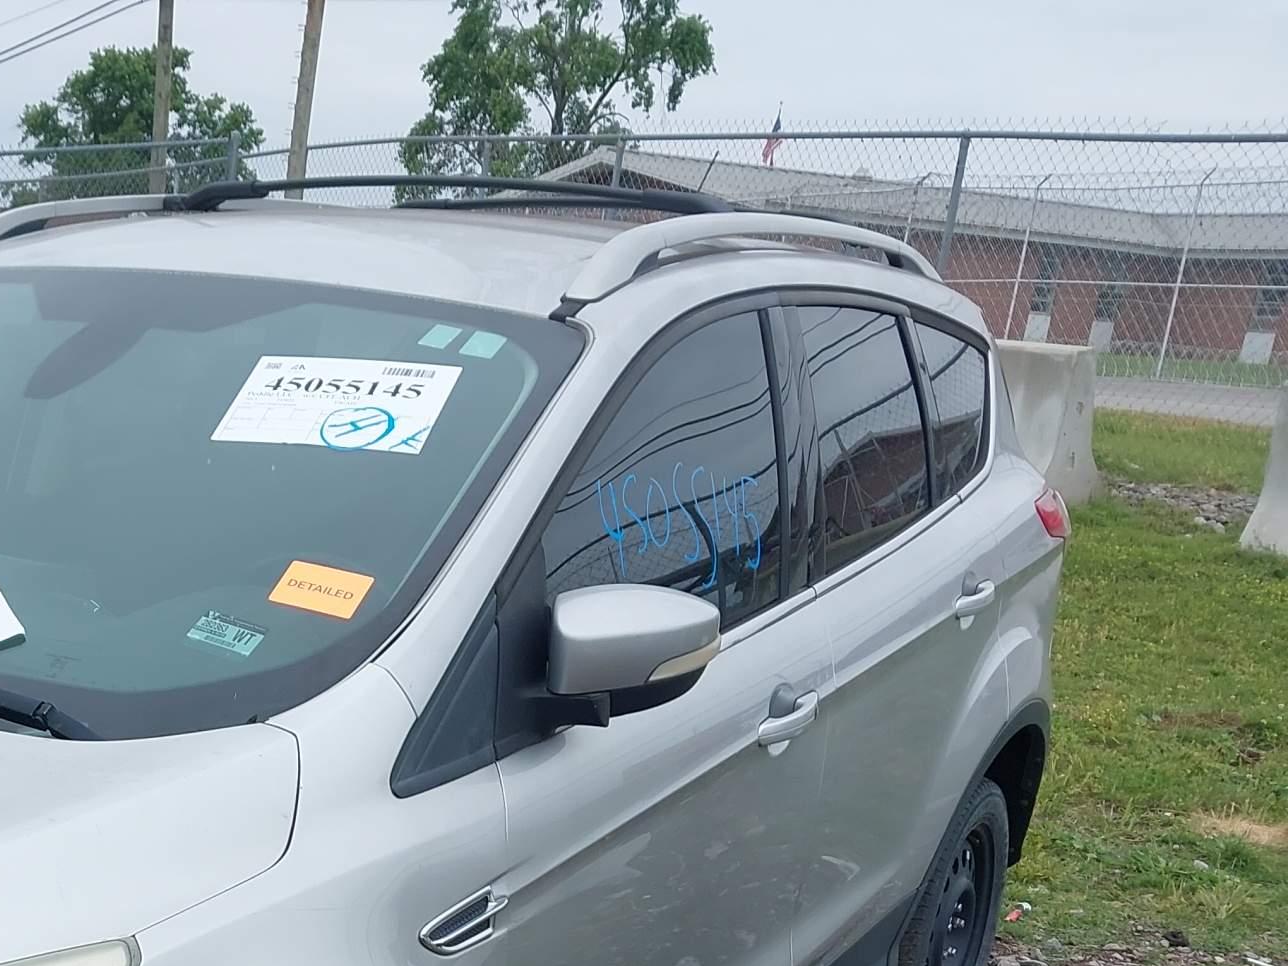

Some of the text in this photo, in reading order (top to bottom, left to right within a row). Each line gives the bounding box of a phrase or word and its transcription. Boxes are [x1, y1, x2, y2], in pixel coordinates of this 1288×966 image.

[264, 375, 426, 400] 45055145
[287, 577, 355, 601] DETAILED
[232, 628, 257, 646] WT
